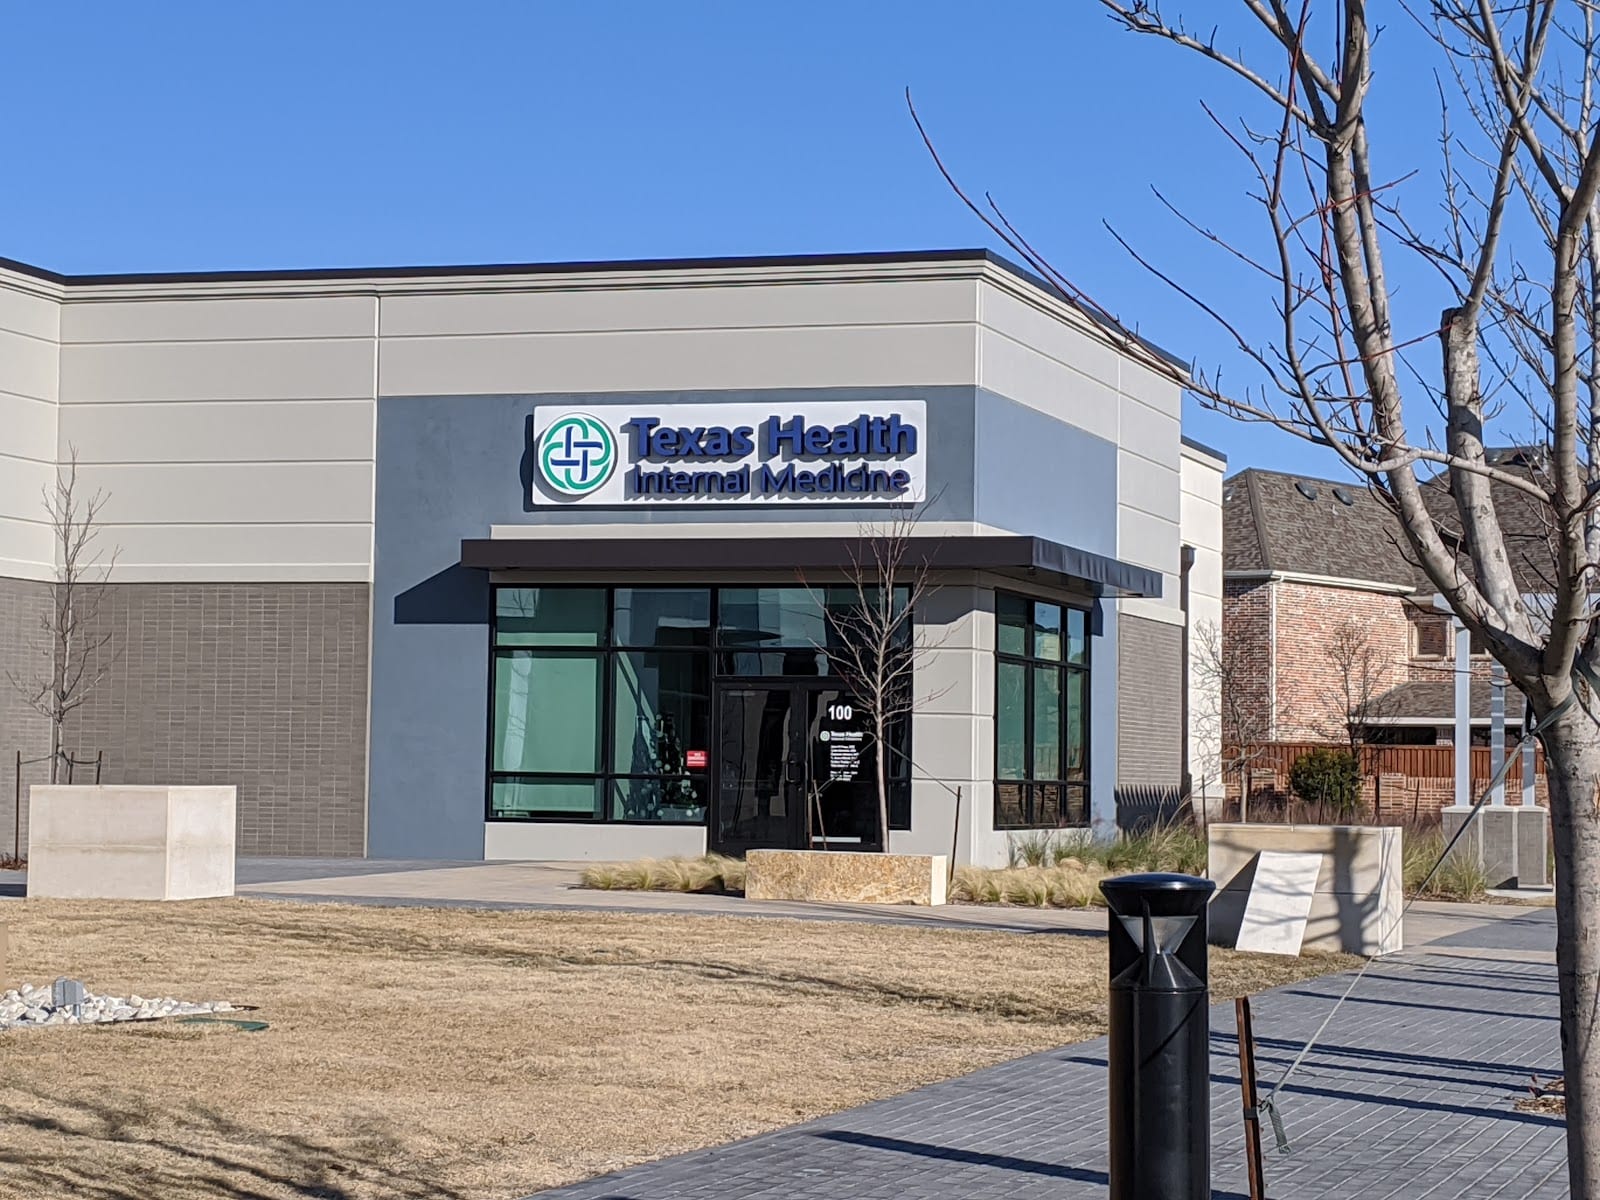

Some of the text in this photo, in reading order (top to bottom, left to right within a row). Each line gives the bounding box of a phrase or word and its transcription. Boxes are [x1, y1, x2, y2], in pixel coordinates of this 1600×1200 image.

[629, 413, 917, 457] Texas Health
[633, 461, 911, 493] Internal Medicine
[828, 705, 852, 720] 100
